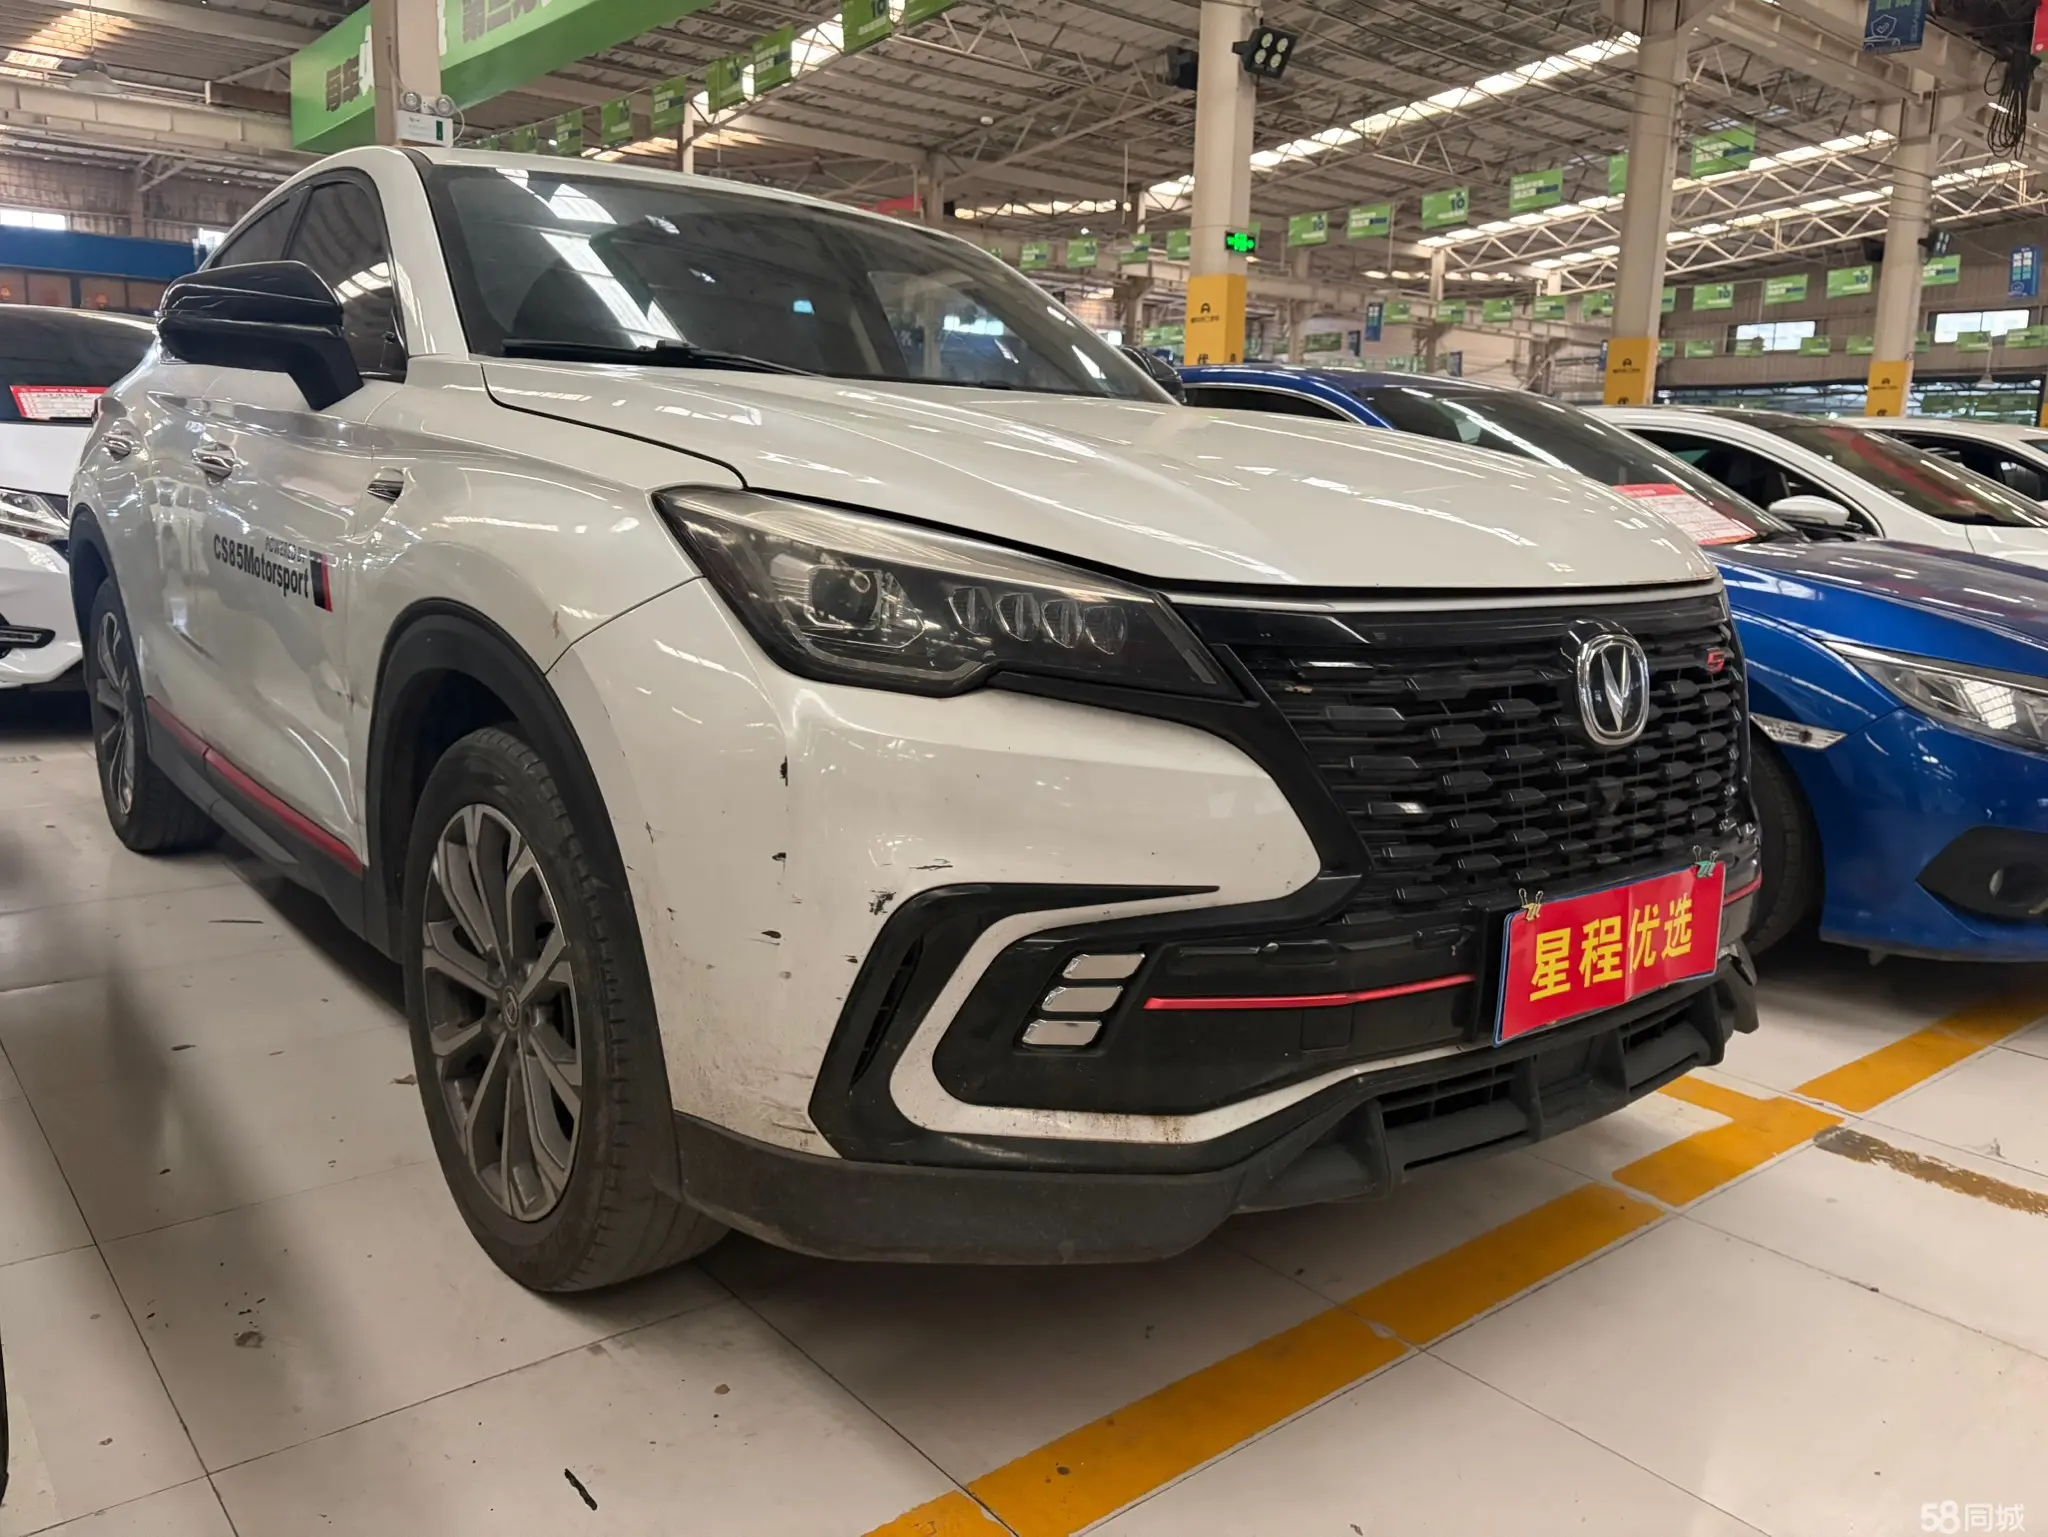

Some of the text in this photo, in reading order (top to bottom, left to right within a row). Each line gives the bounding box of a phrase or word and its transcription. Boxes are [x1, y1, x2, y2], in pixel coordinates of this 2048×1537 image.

[1450, 197, 1466, 212] 10
[213, 533, 309, 599] CS85Motorsport
[1529, 892, 1693, 1002] 星程优选
